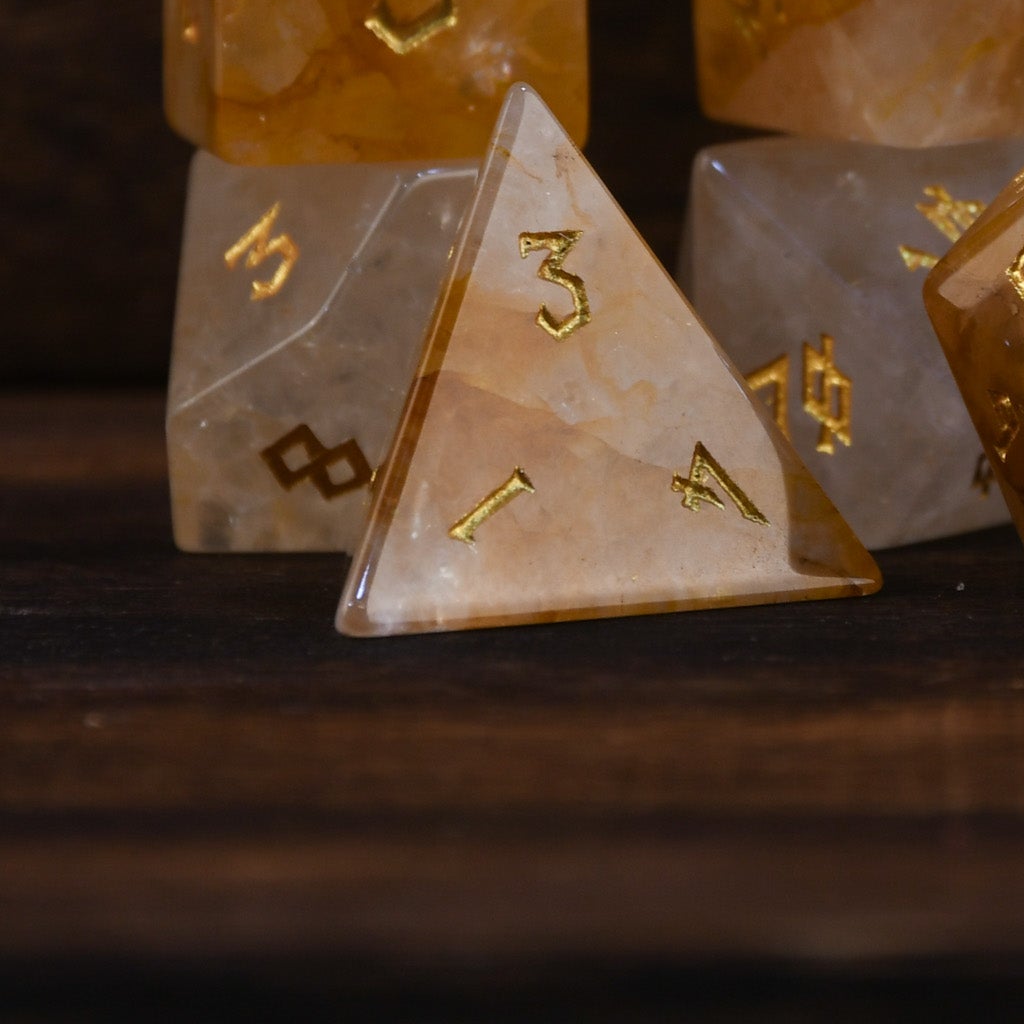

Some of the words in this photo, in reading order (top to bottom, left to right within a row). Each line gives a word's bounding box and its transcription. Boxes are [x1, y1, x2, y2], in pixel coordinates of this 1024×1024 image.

[224, 202, 298, 301] 3
[518, 229, 591, 341] 3
[260, 424, 374, 499] 8
[671, 441, 772, 527] 4
[448, 466, 535, 544] 1
